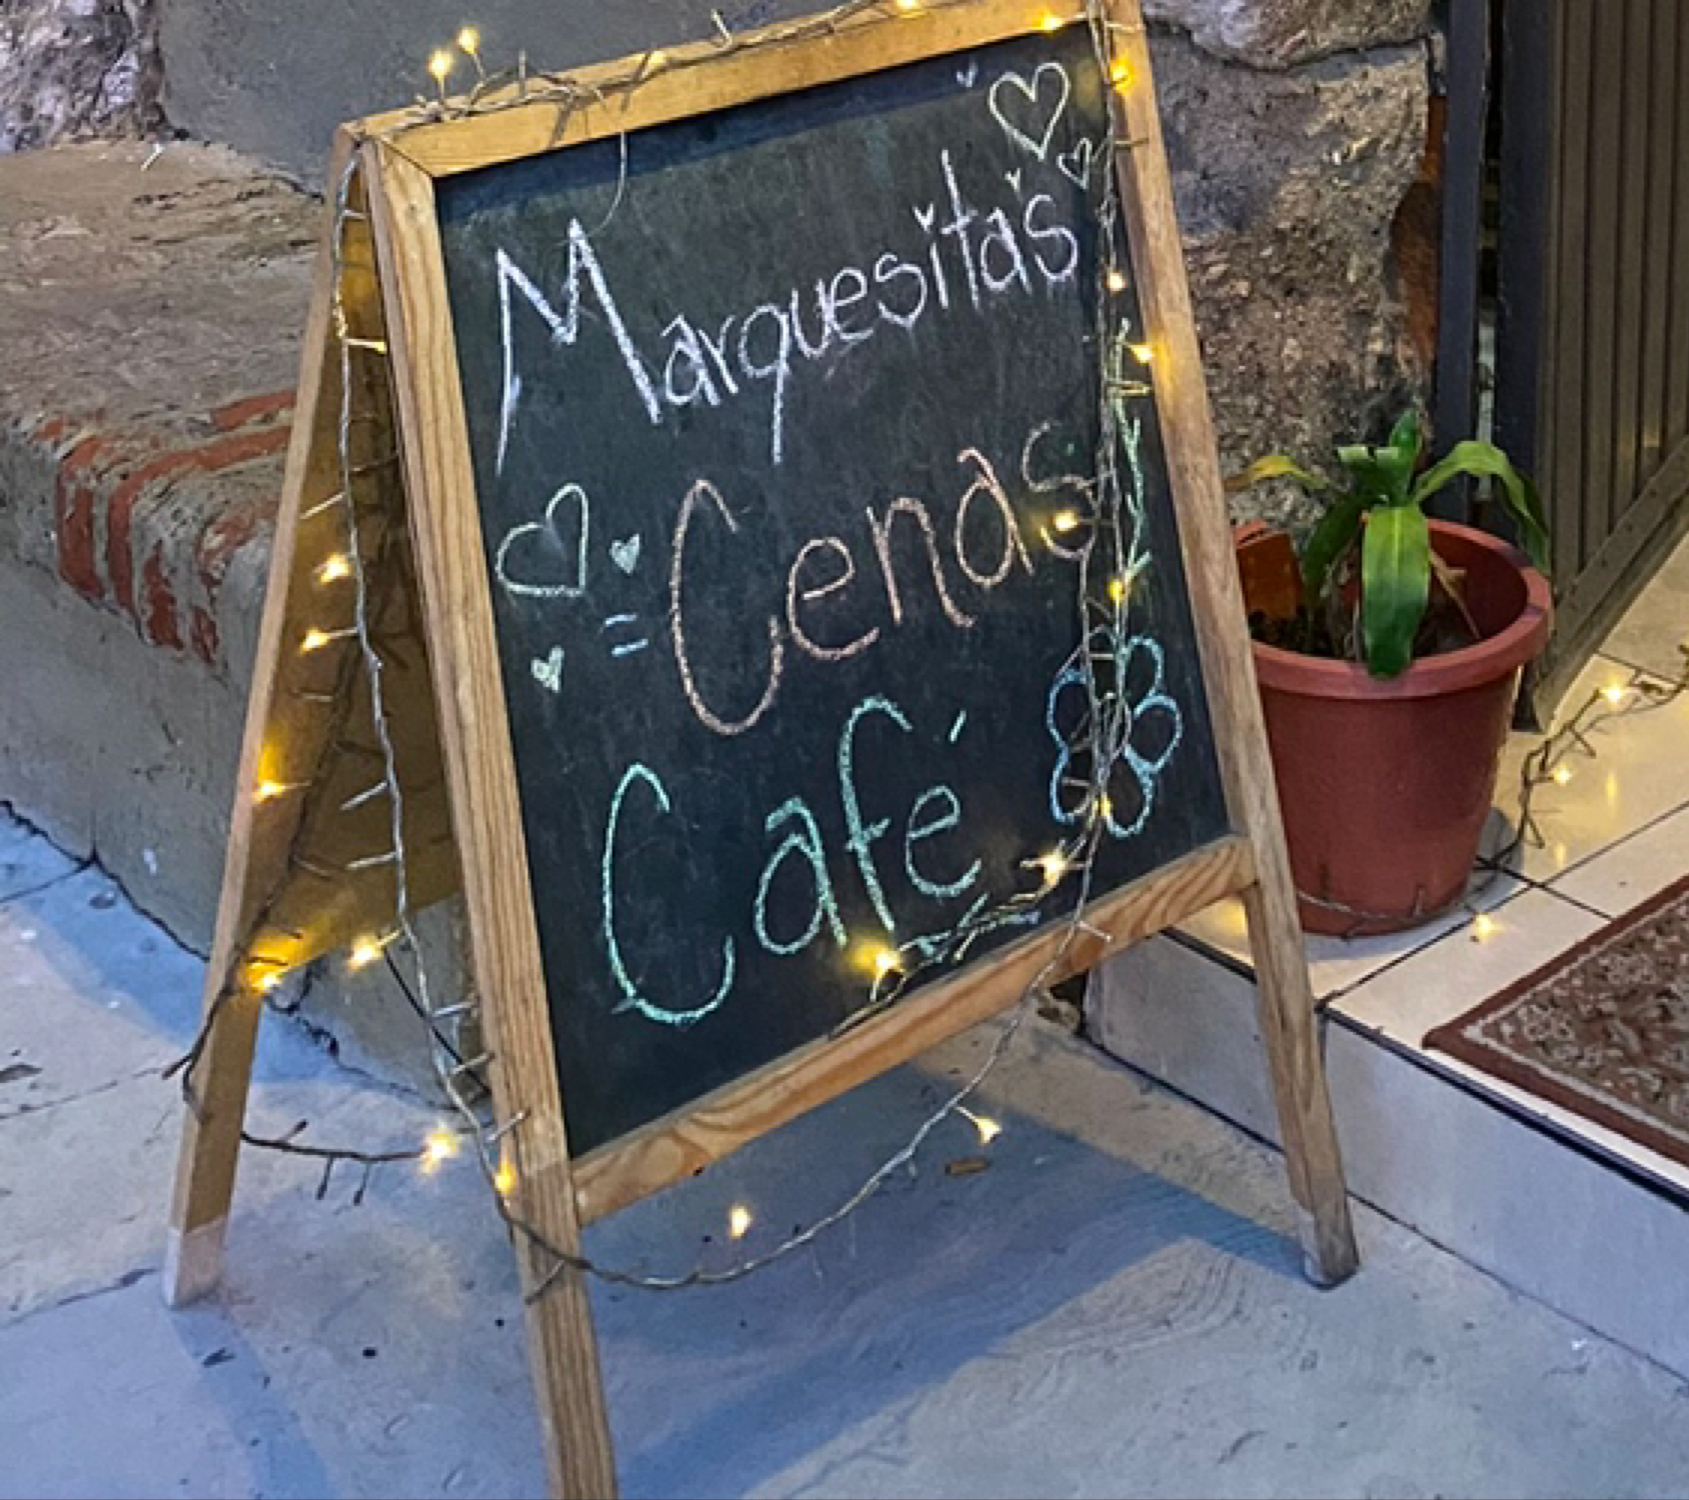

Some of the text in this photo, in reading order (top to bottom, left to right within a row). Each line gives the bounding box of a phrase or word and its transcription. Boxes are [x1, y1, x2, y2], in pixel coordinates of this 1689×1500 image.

[494, 150, 1079, 476] Marquesitas
[671, 423, 1099, 735] Cenas
[602, 695, 981, 1024] Café
